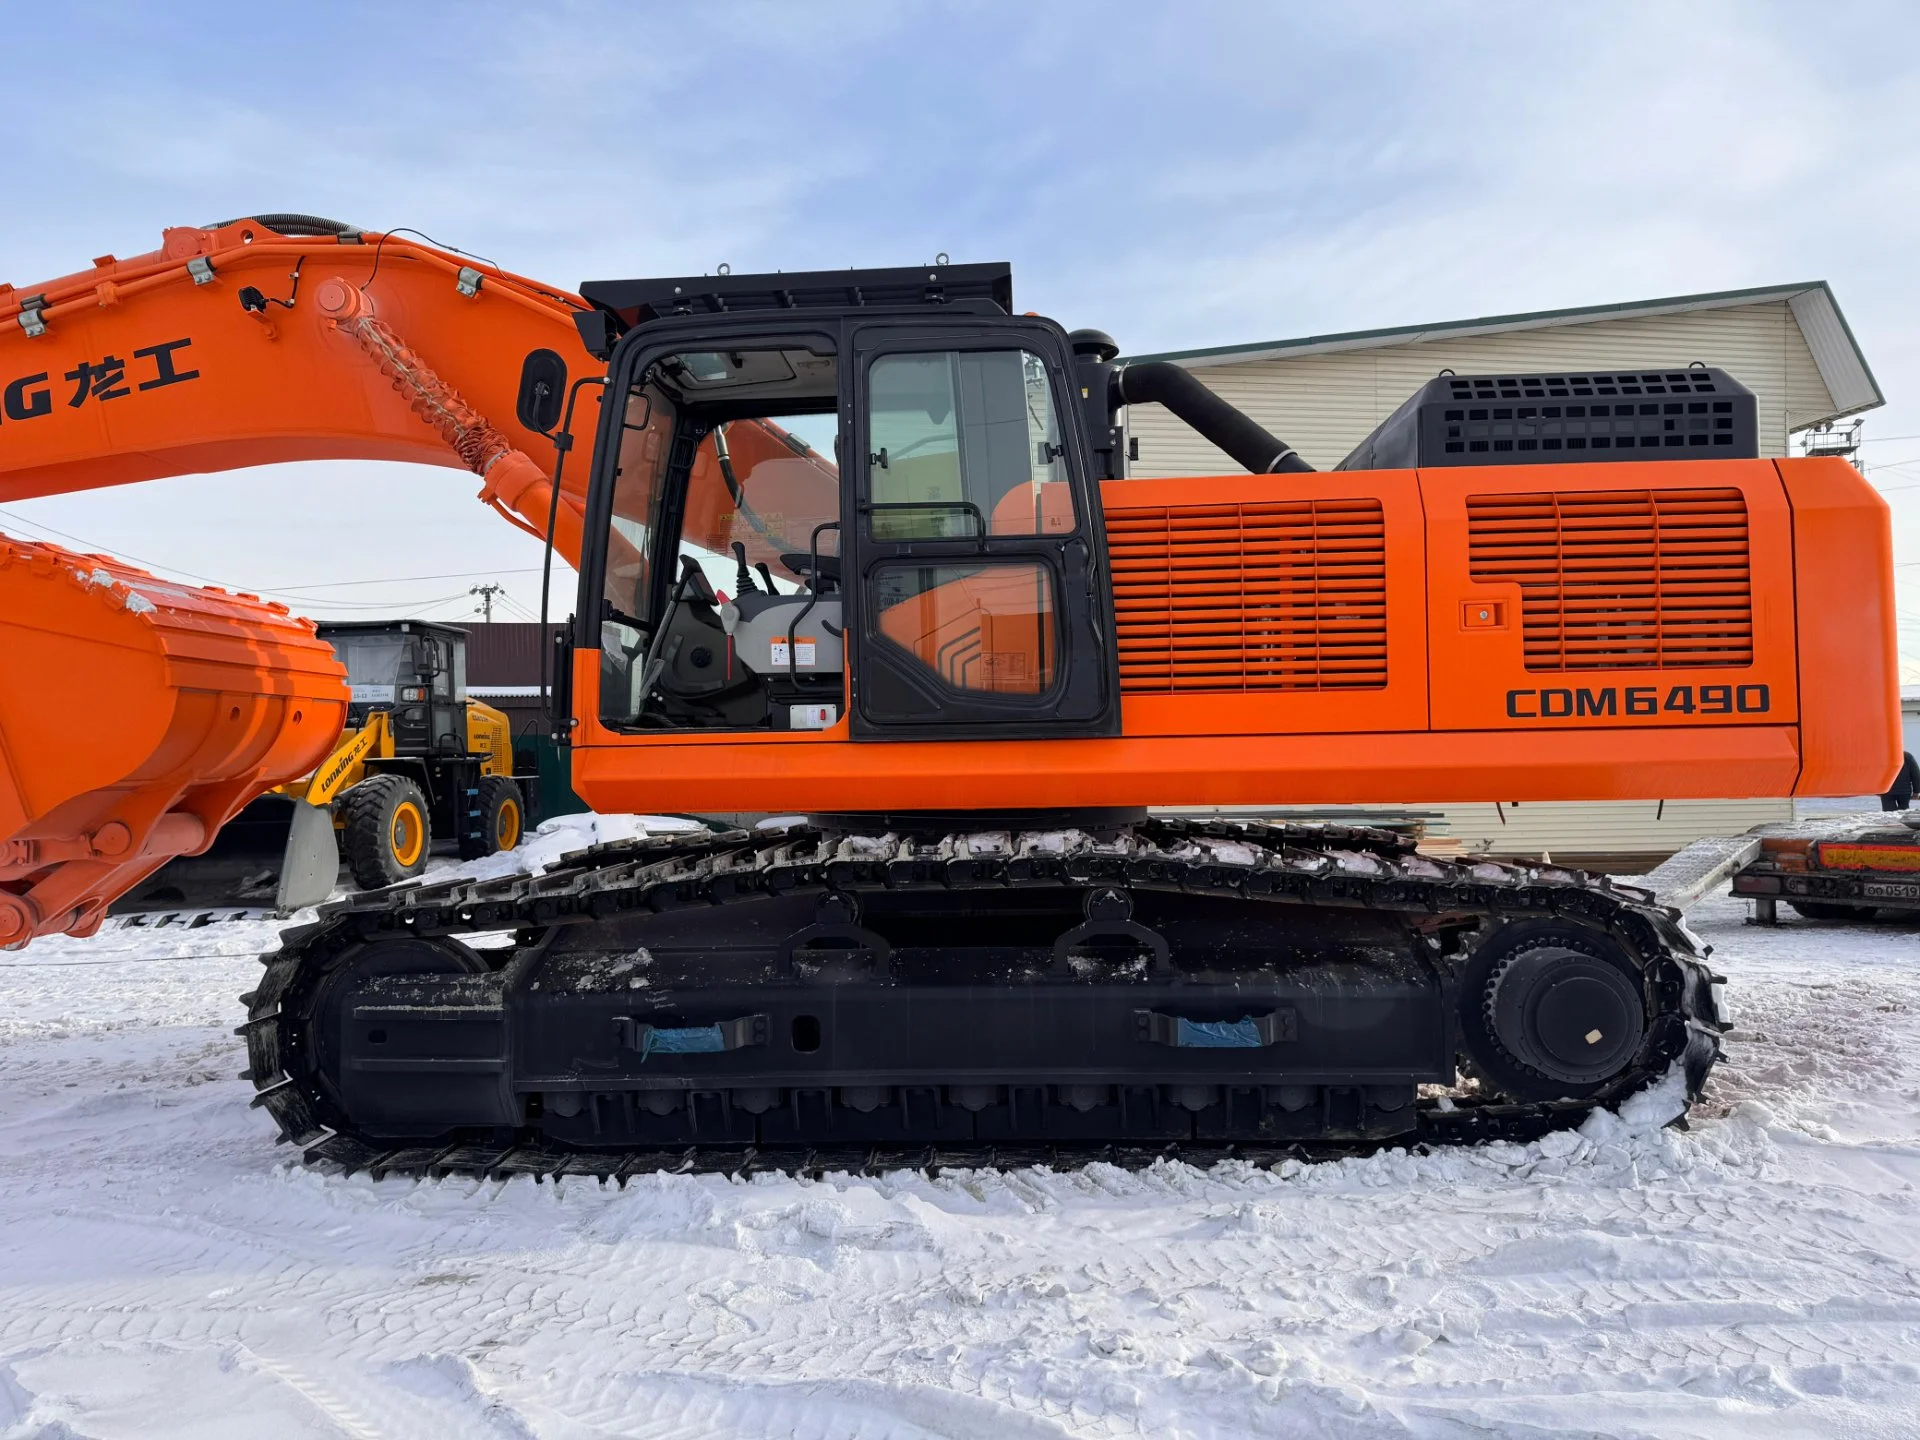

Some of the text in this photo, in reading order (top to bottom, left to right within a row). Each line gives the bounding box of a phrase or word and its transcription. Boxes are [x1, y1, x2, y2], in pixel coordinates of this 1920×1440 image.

[0, 338, 200, 425] G 龙工
[1506, 684, 1770, 718] CDM6490
